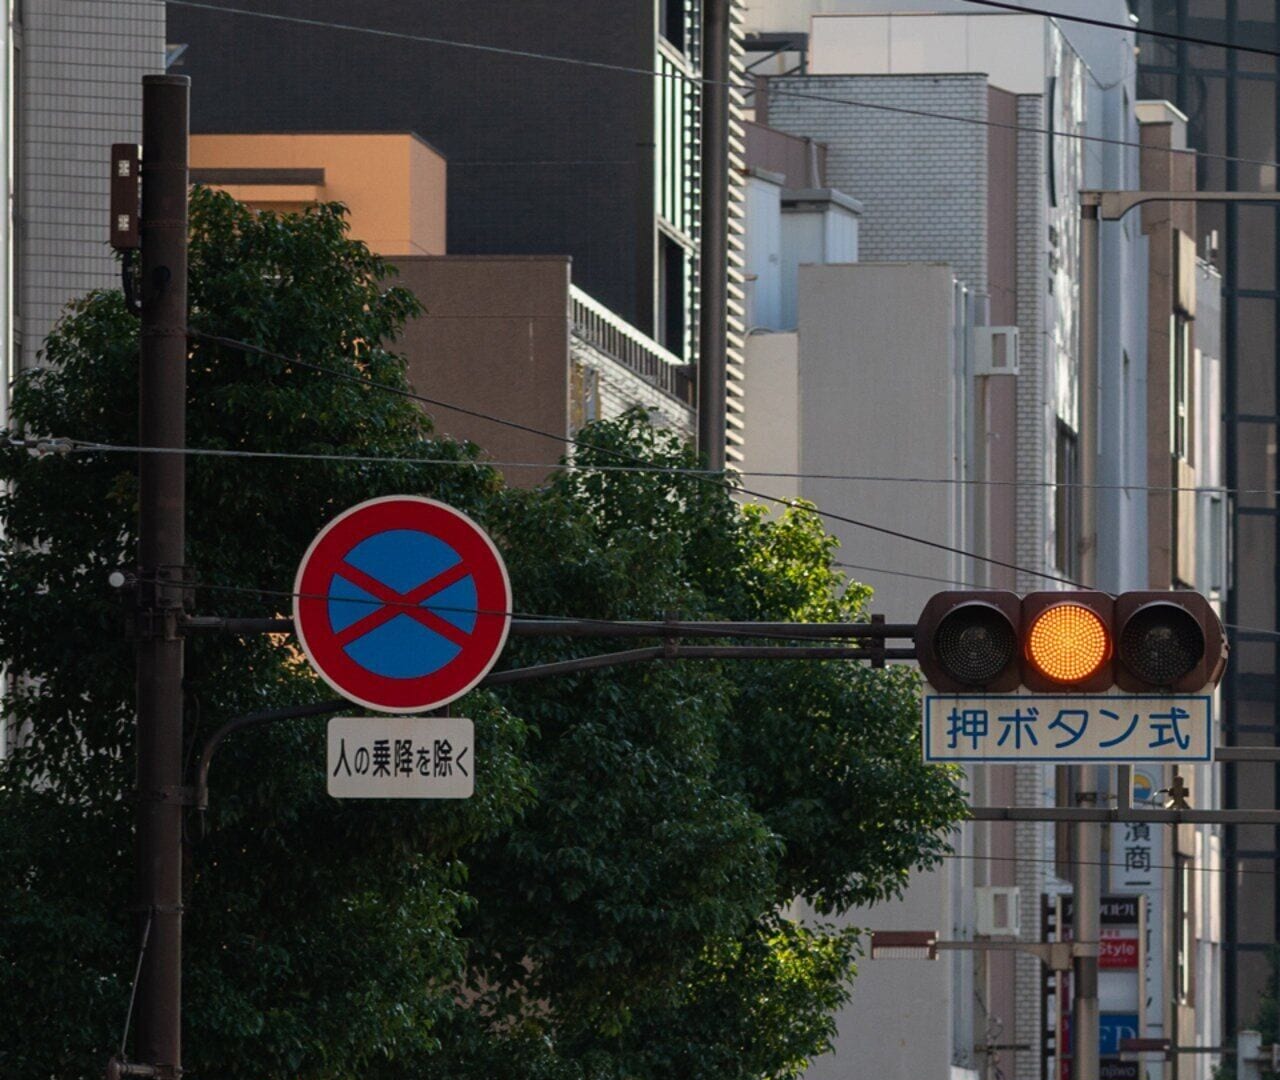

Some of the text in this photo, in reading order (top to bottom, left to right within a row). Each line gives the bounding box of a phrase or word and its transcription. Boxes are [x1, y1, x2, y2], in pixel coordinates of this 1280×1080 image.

[946, 707, 1190, 750] 押ボタン式
[333, 738, 470, 779] 人の乗降を除く
